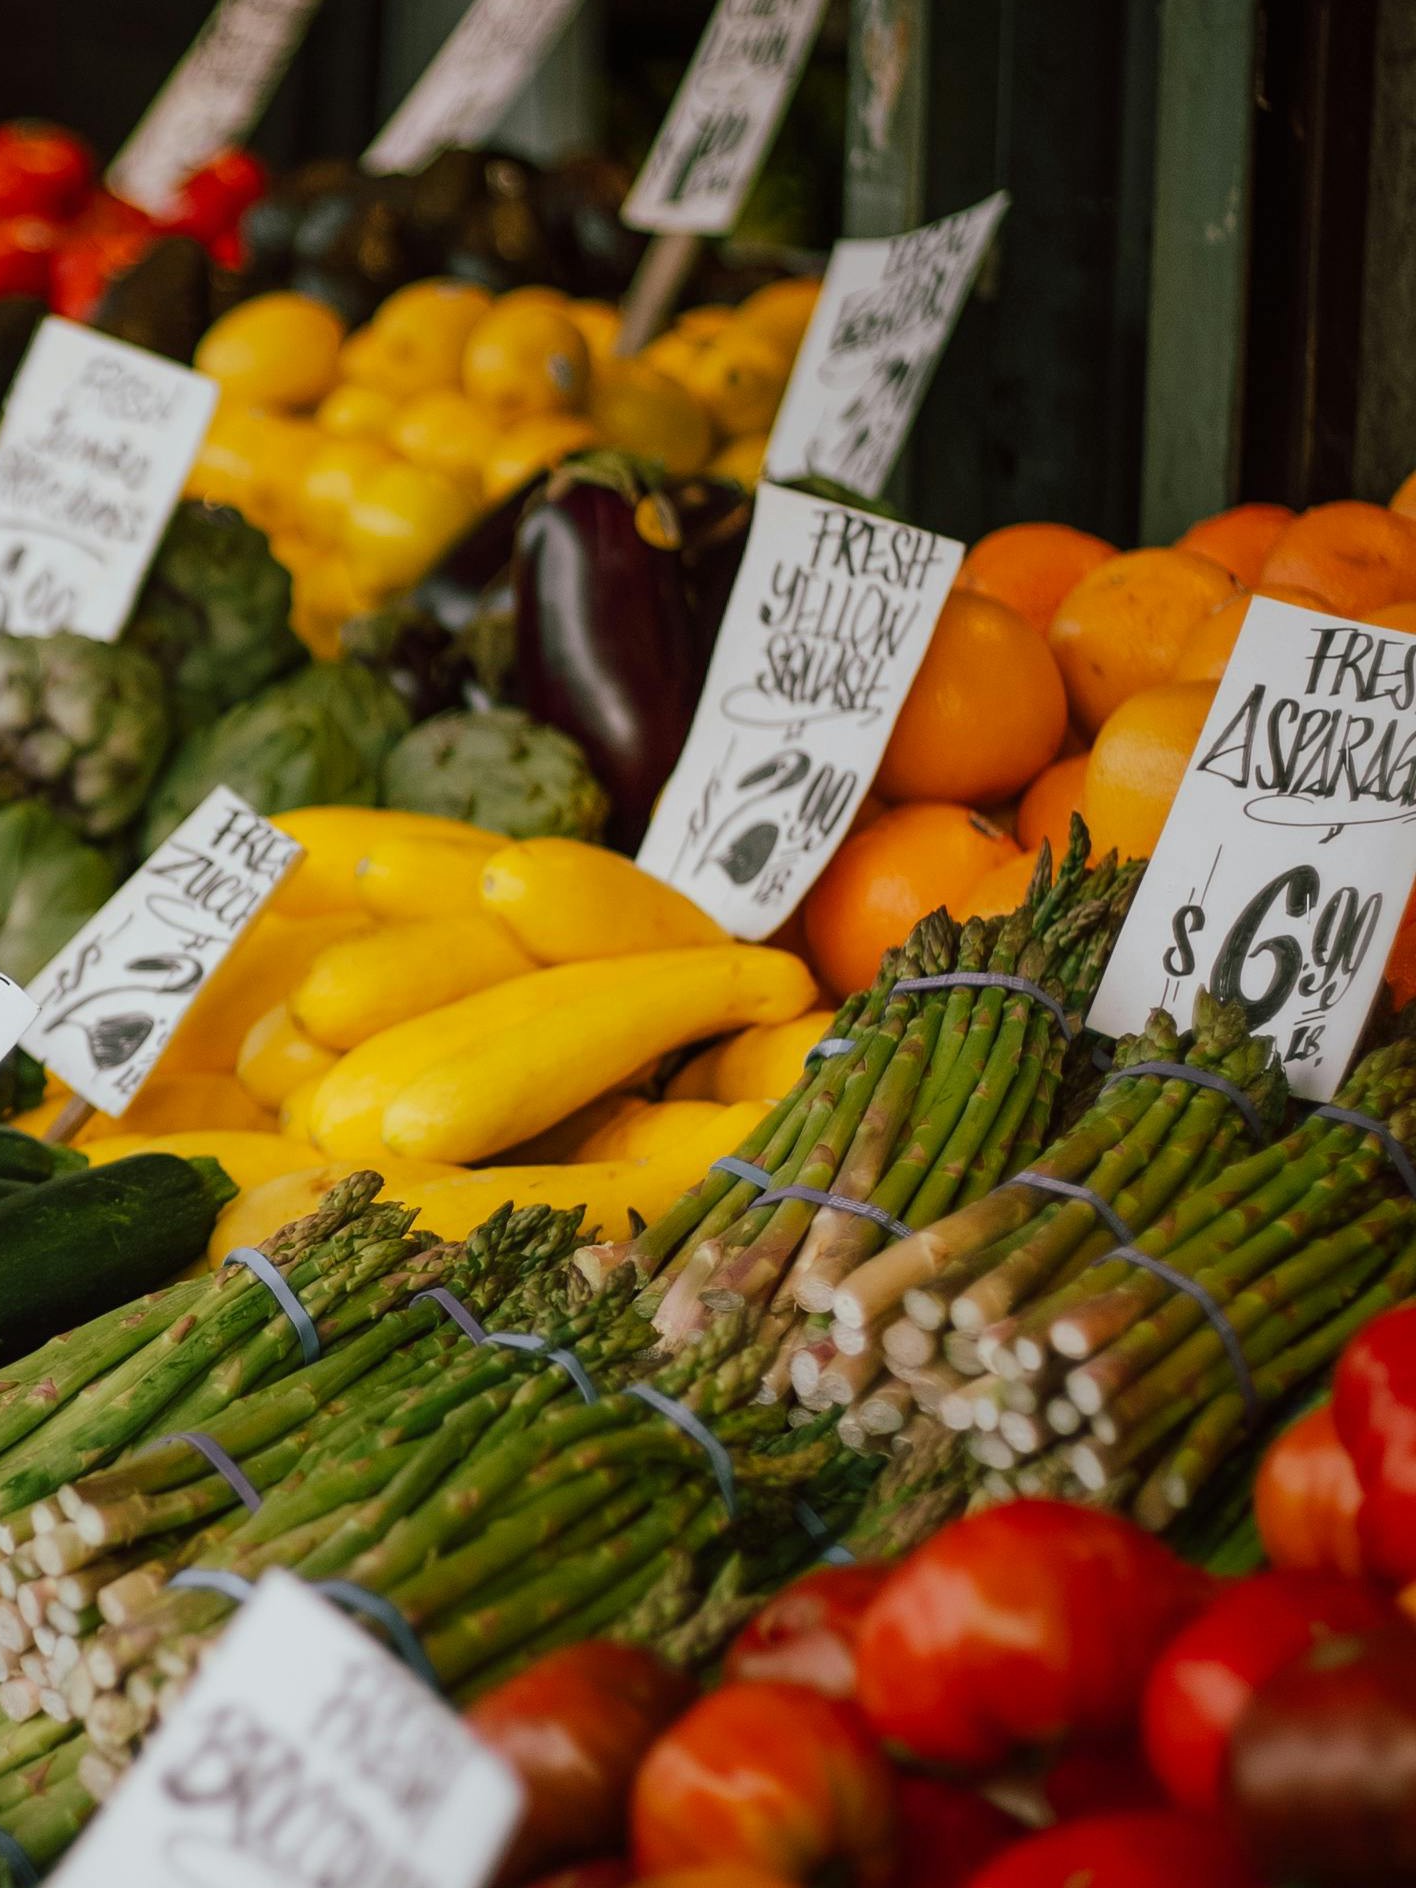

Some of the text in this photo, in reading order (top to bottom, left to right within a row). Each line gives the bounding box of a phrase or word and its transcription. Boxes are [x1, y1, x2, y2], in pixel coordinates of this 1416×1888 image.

[810, 508, 943, 591] FRESH
[759, 560, 921, 658] YELLOW
[755, 633, 889, 711] SQUASH
